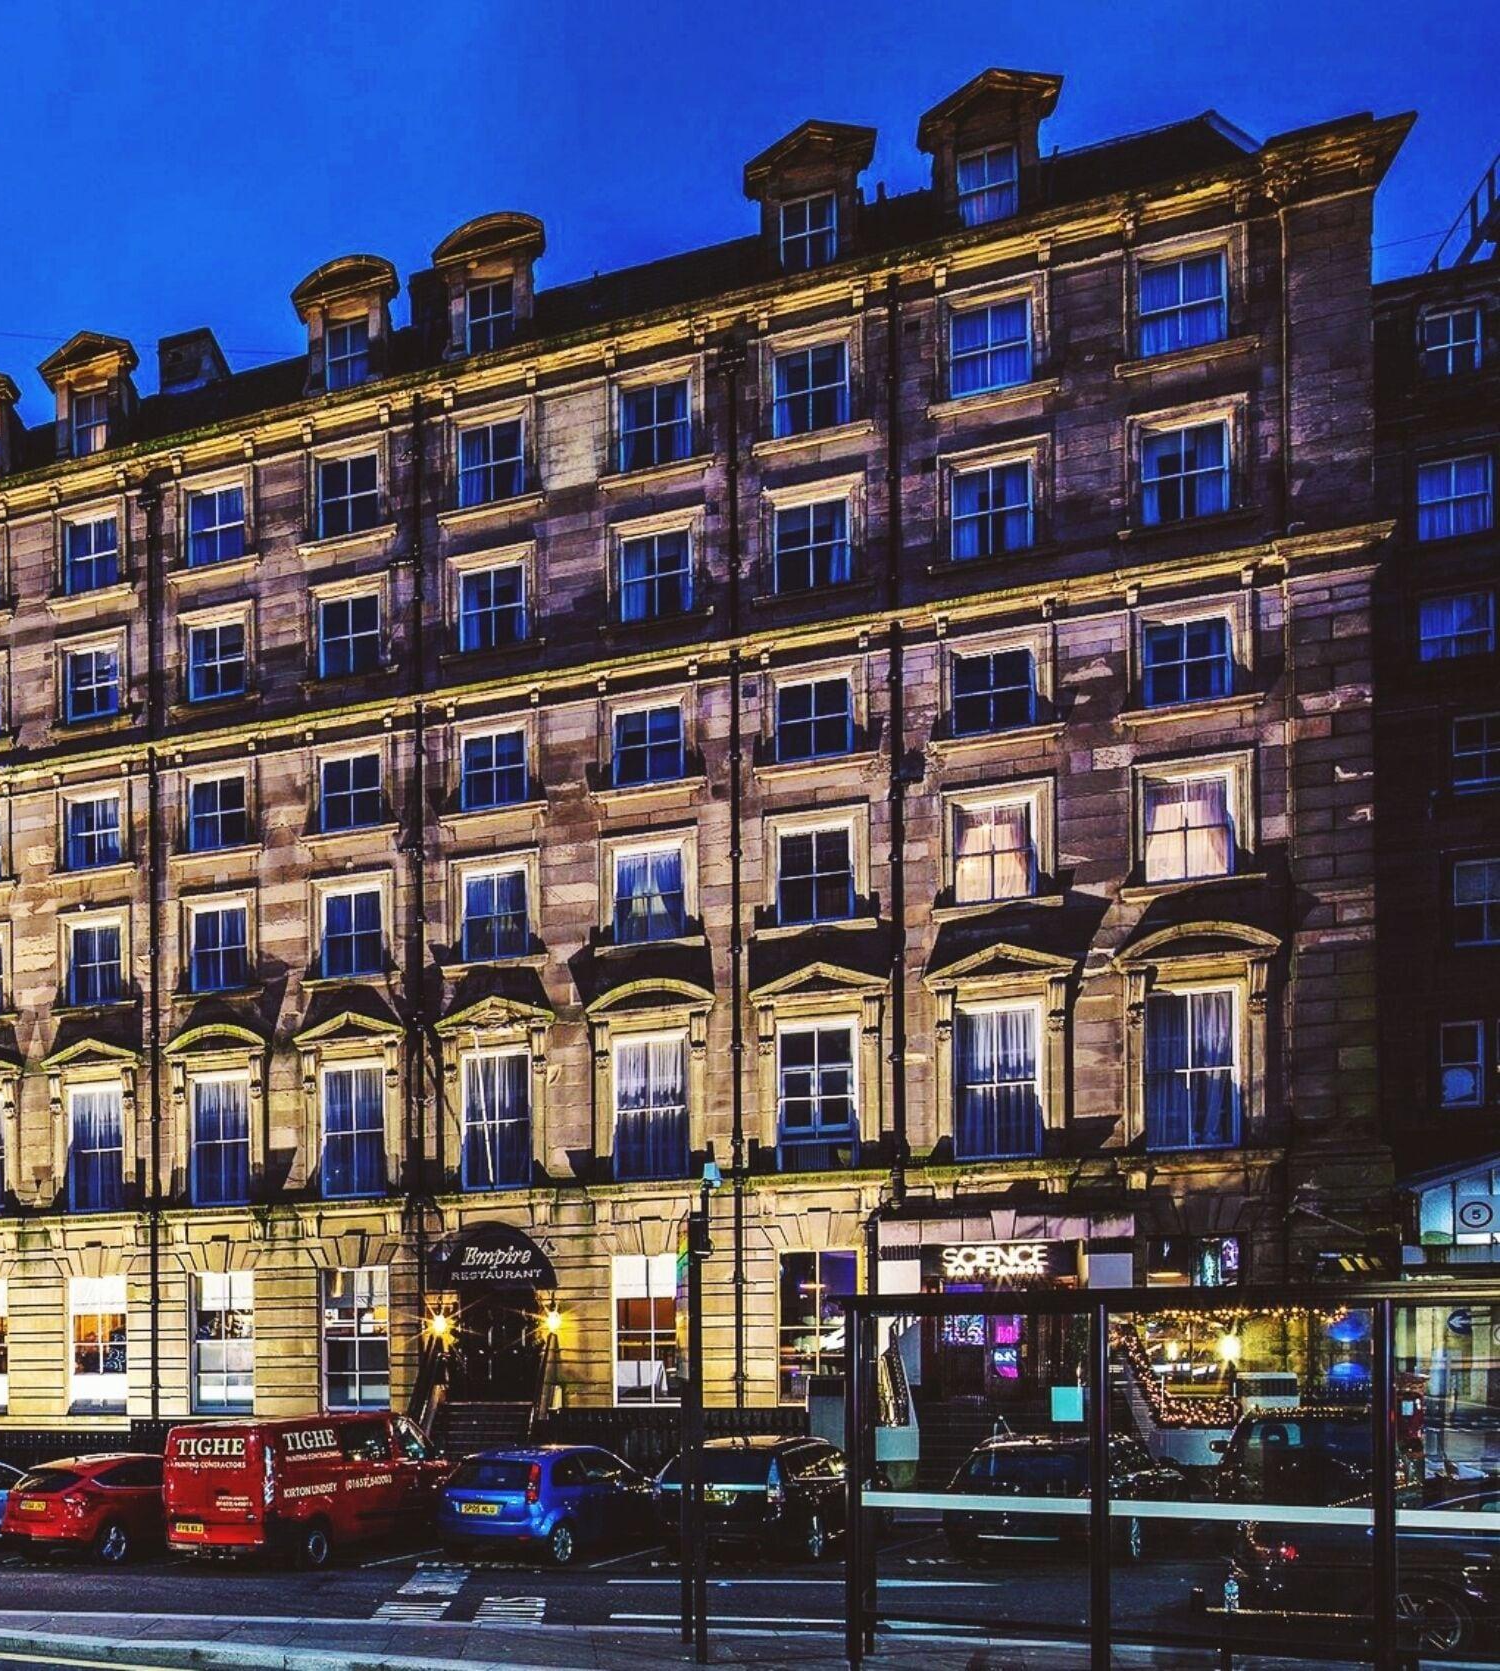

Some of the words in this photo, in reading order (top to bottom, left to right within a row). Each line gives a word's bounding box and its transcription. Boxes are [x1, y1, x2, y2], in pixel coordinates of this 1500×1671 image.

[1471, 1207, 1482, 1220] 5
[461, 1245, 532, 1269] Empire
[942, 1245, 1050, 1267] SCIENCE
[451, 1269, 542, 1280] RESTAURANT
[177, 1437, 246, 1456] TIGHE
[282, 1429, 338, 1451] TIGHE
[283, 1486, 311, 1498] KIRTON
